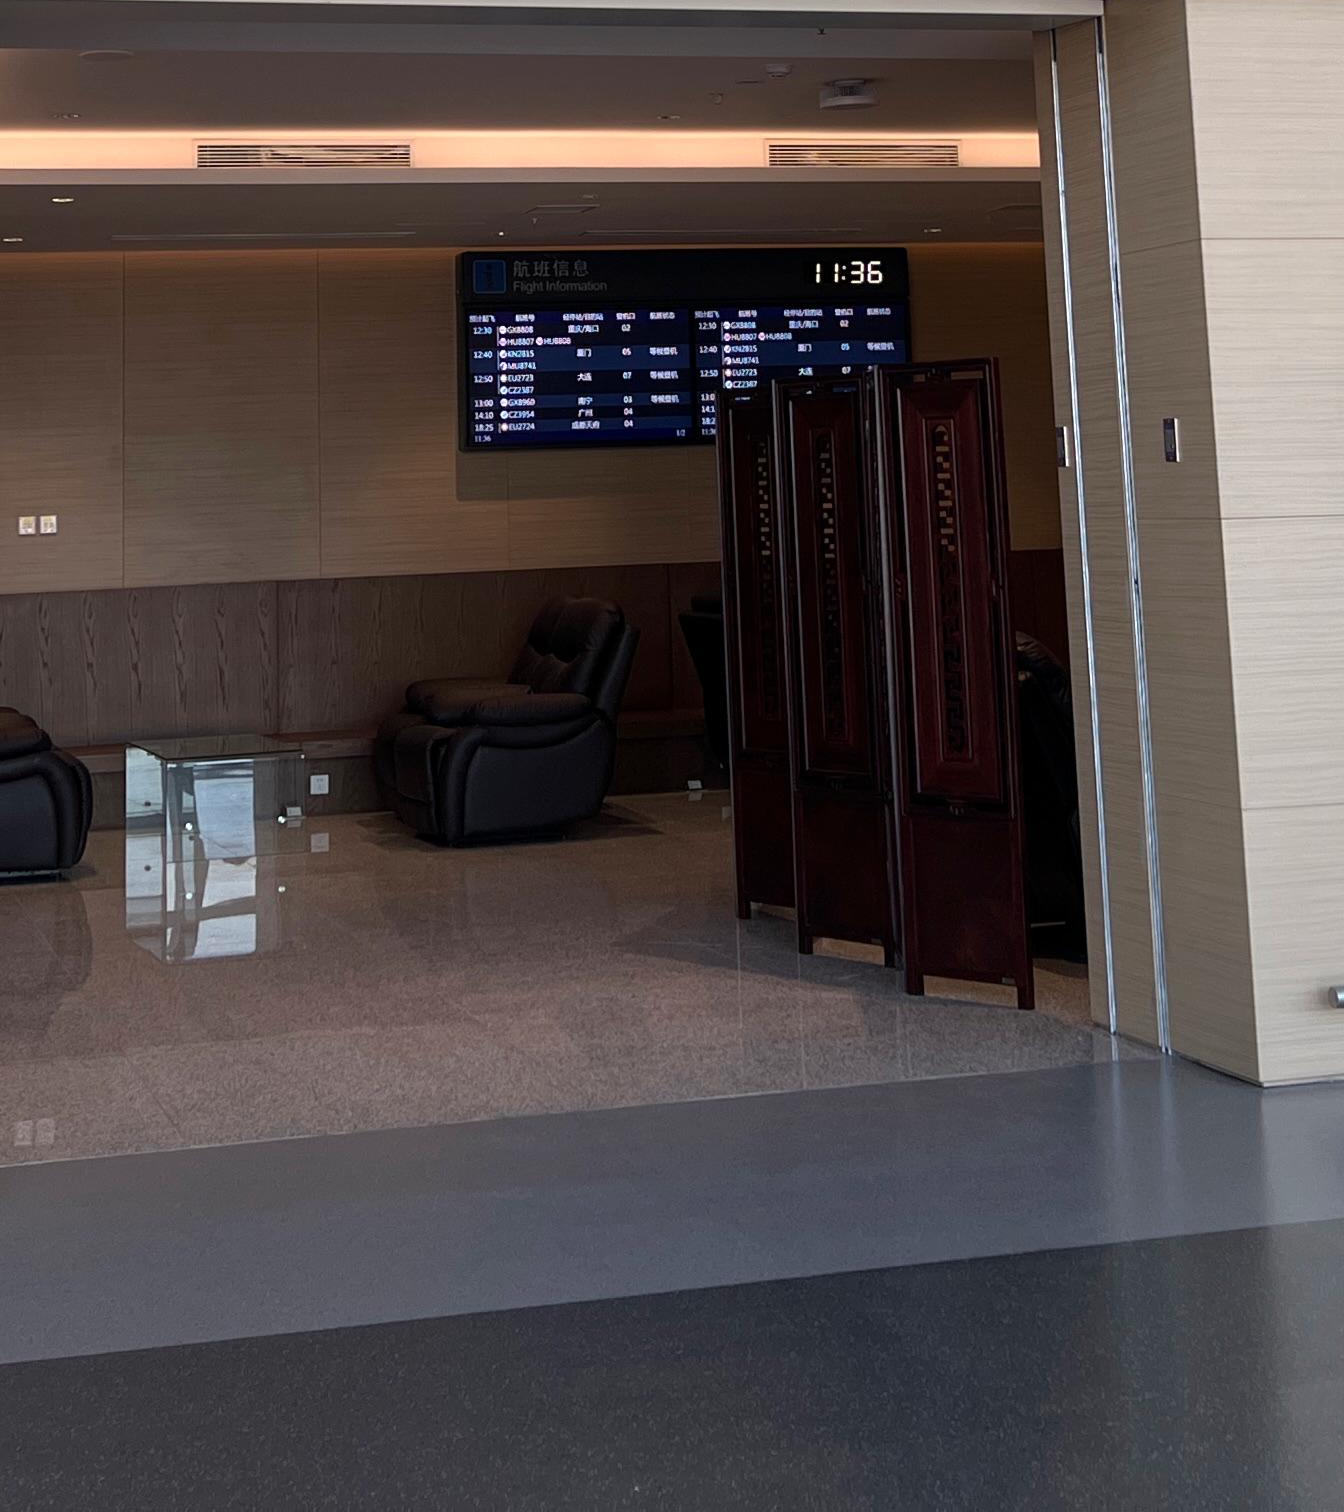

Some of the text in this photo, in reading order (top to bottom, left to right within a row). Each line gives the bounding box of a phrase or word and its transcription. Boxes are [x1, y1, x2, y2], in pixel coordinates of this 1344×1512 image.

[512, 259, 590, 278] 航班信息
[815, 260, 883, 284] 11:36
[512, 280, 608, 295] Flight Information
[473, 326, 493, 335] 12:30
[621, 323, 631, 332] 02
[698, 321, 717, 330] 12:30
[473, 350, 493, 359] 12:40
[699, 345, 718, 354] 12:40
[473, 375, 494, 384] 12:50
[622, 371, 632, 380] 07
[699, 369, 719, 378] 12:50
[841, 366, 852, 375] 07
[474, 399, 494, 408] 13:00
[623, 395, 633, 404] 03
[700, 393, 716, 402] 13:0
[474, 411, 494, 420] 14:10
[623, 407, 634, 416] 04
[701, 405, 716, 414] 14:1
[474, 423, 494, 432] 18:25
[623, 419, 634, 428] 04
[701, 417, 716, 426] 18:2
